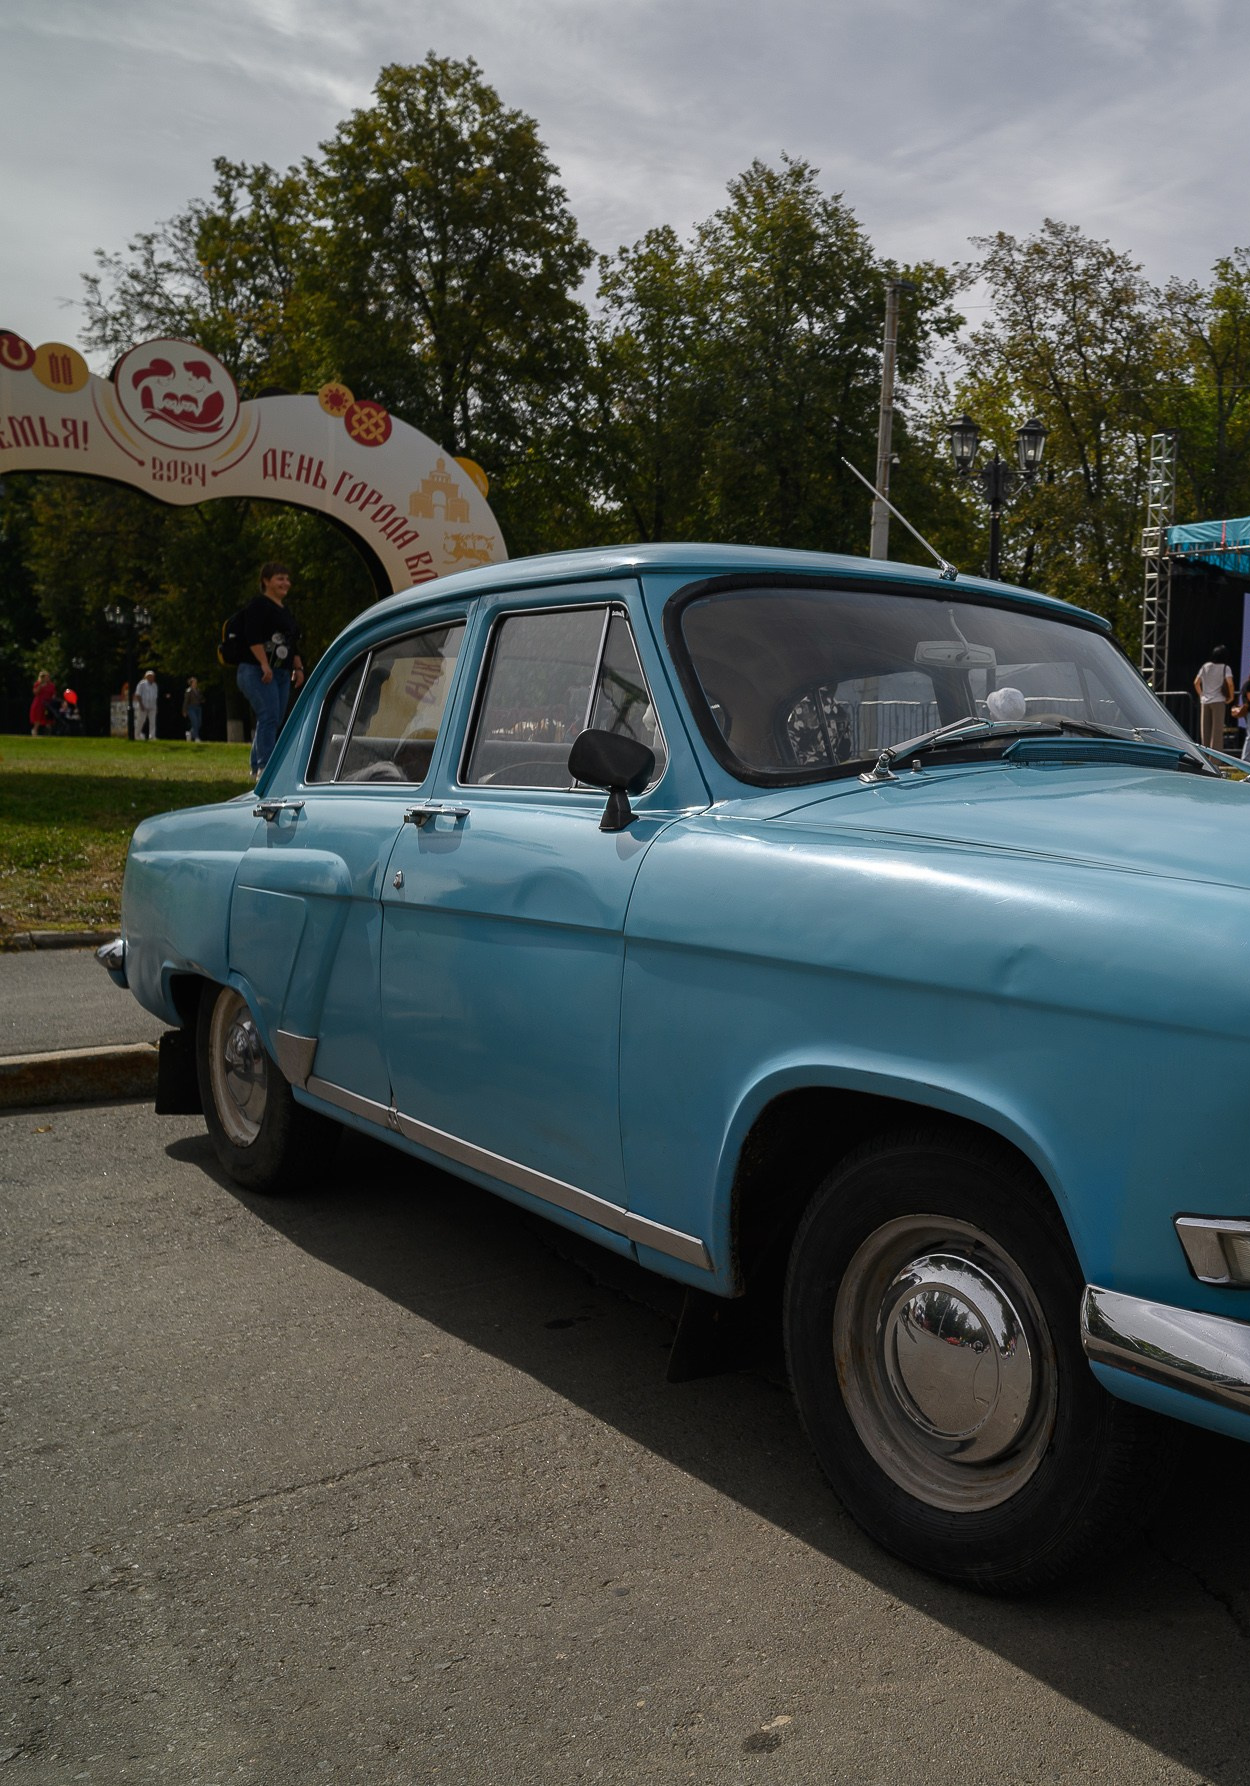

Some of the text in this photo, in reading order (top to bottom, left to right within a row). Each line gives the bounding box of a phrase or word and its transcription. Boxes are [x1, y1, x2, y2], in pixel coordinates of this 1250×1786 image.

[151, 456, 207, 487] 2024
[262, 448, 328, 490] ДЕНЬ
[332, 470, 420, 550] ГОРОДА
